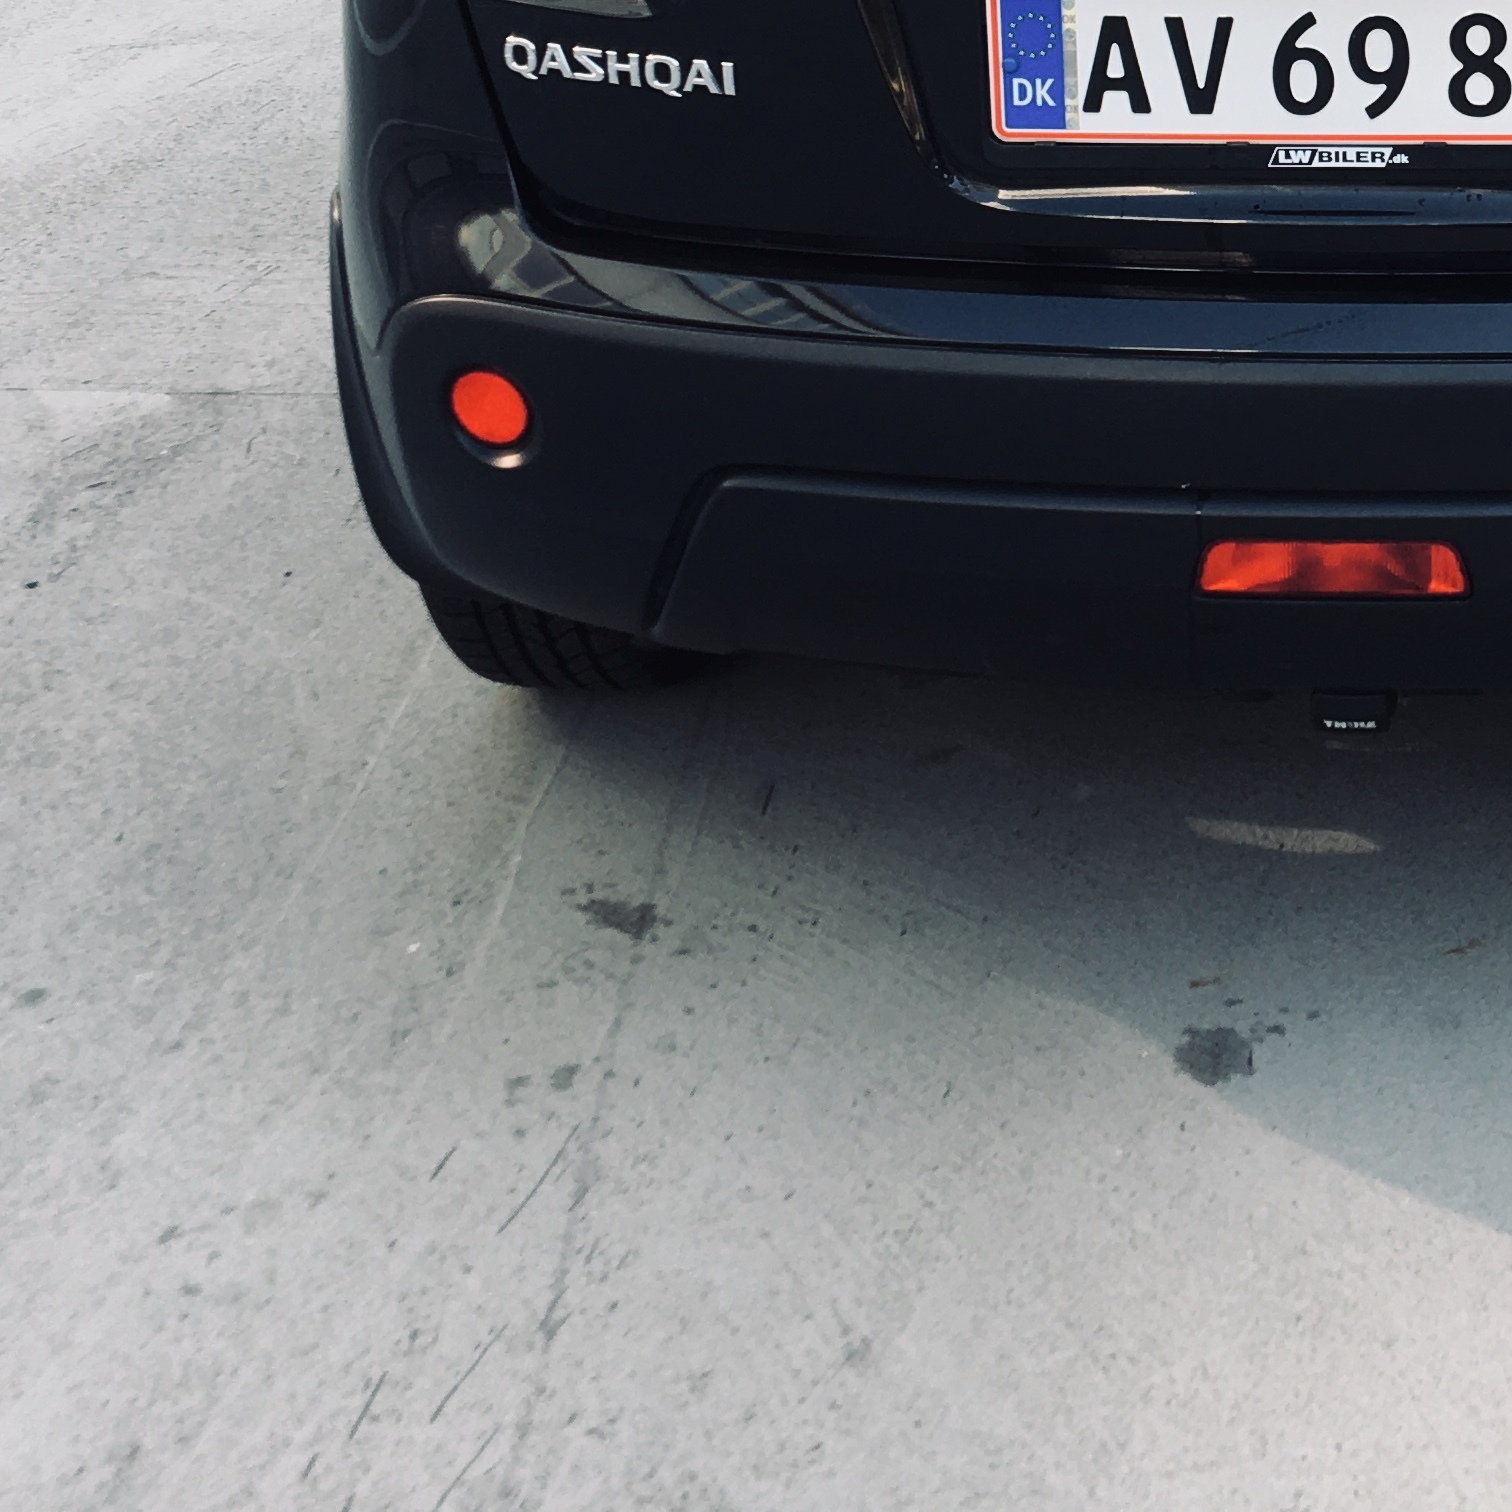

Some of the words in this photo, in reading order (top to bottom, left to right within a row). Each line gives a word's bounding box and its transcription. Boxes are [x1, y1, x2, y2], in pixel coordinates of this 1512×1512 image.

[503, 35, 736, 97] QASHQAI
[1012, 77, 1057, 107] DK
[1082, 15, 1234, 115] AV
[1272, 11, 1410, 120] 69
